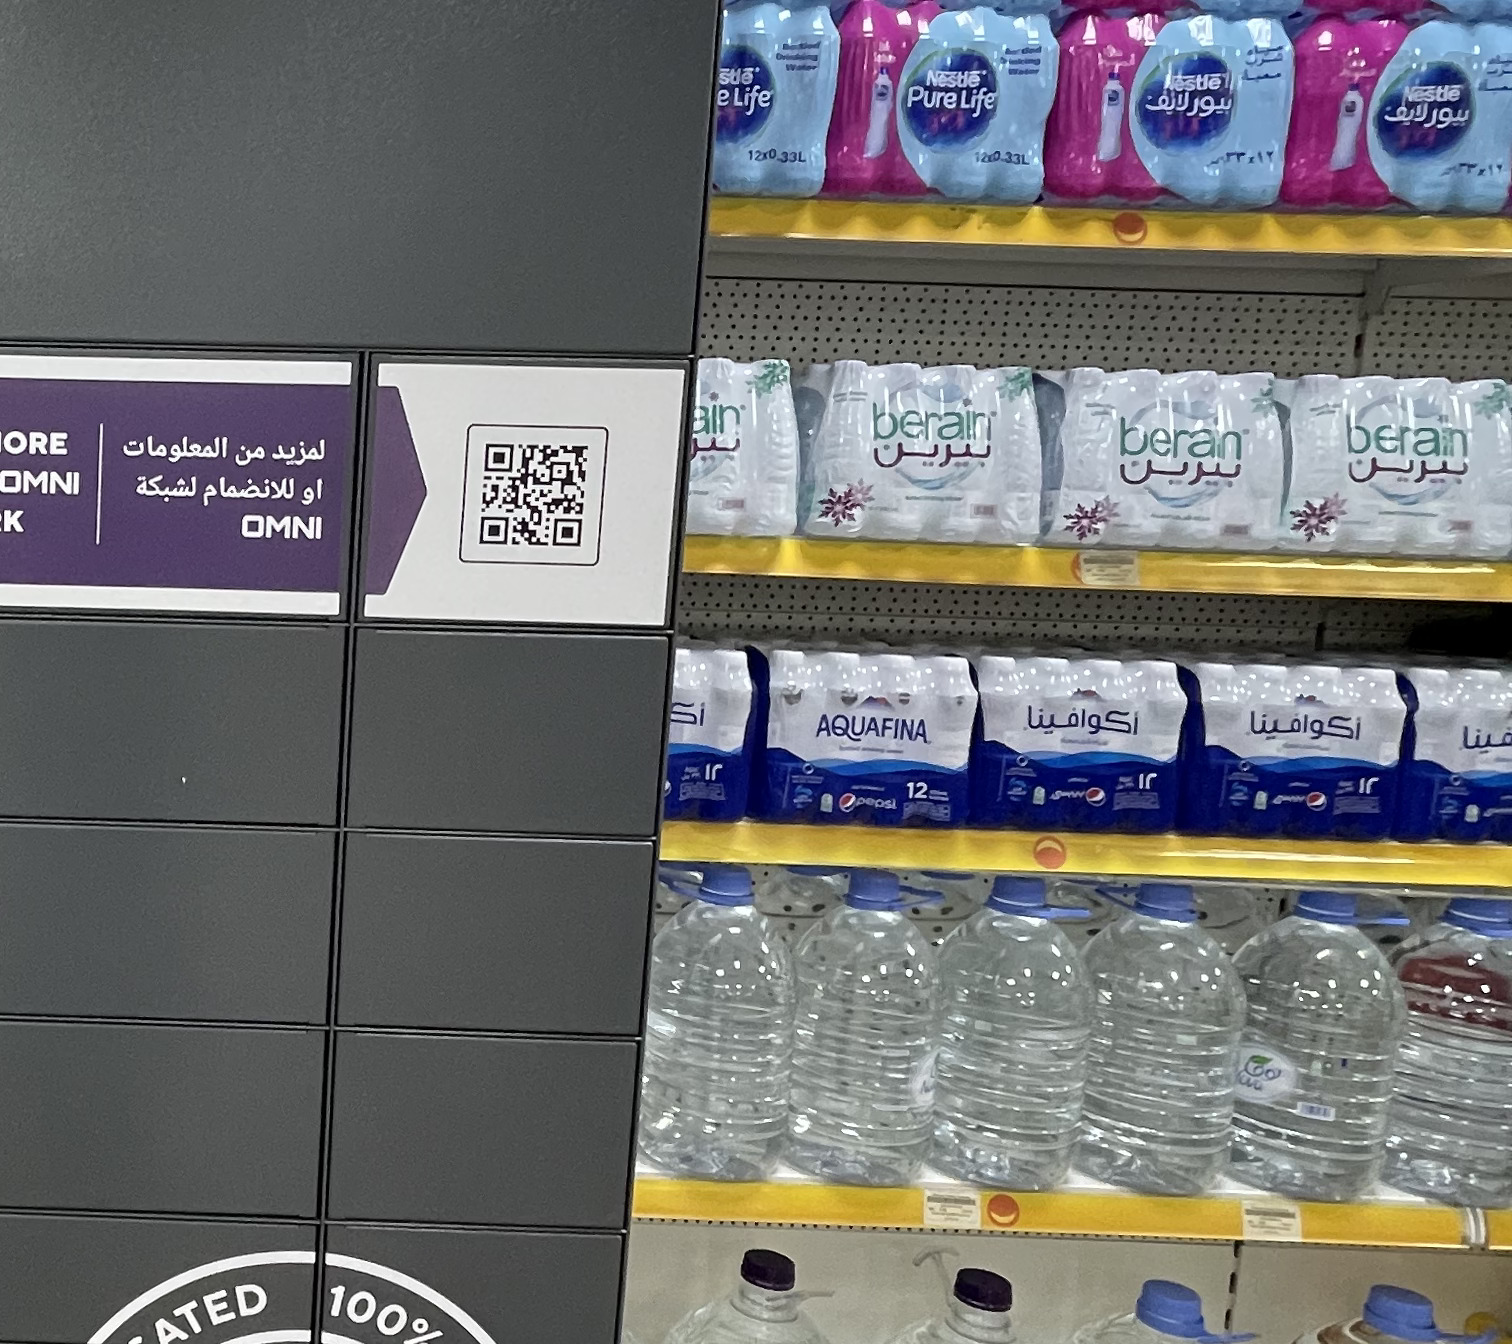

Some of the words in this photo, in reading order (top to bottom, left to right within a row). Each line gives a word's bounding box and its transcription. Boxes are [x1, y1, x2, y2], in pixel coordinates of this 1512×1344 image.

[733, 85, 771, 115] Life
[907, 85, 958, 109] Pure
[960, 87, 995, 118] Life
[873, 398, 991, 441] berain
[123, 435, 228, 463] المعلومات
[235, 439, 266, 465] من
[271, 439, 325, 466] لمزيد
[874, 442, 991, 468] بيرين
[1120, 459, 1241, 488] بيرين
[1348, 457, 1468, 485] بيرين
[135, 474, 197, 502] لشبكة
[203, 476, 295, 507] للانضمام
[301, 478, 324, 506] او
[241, 514, 323, 540] OMNI
[816, 713, 928, 744] AQUAFINA
[907, 782, 928, 799] 12
